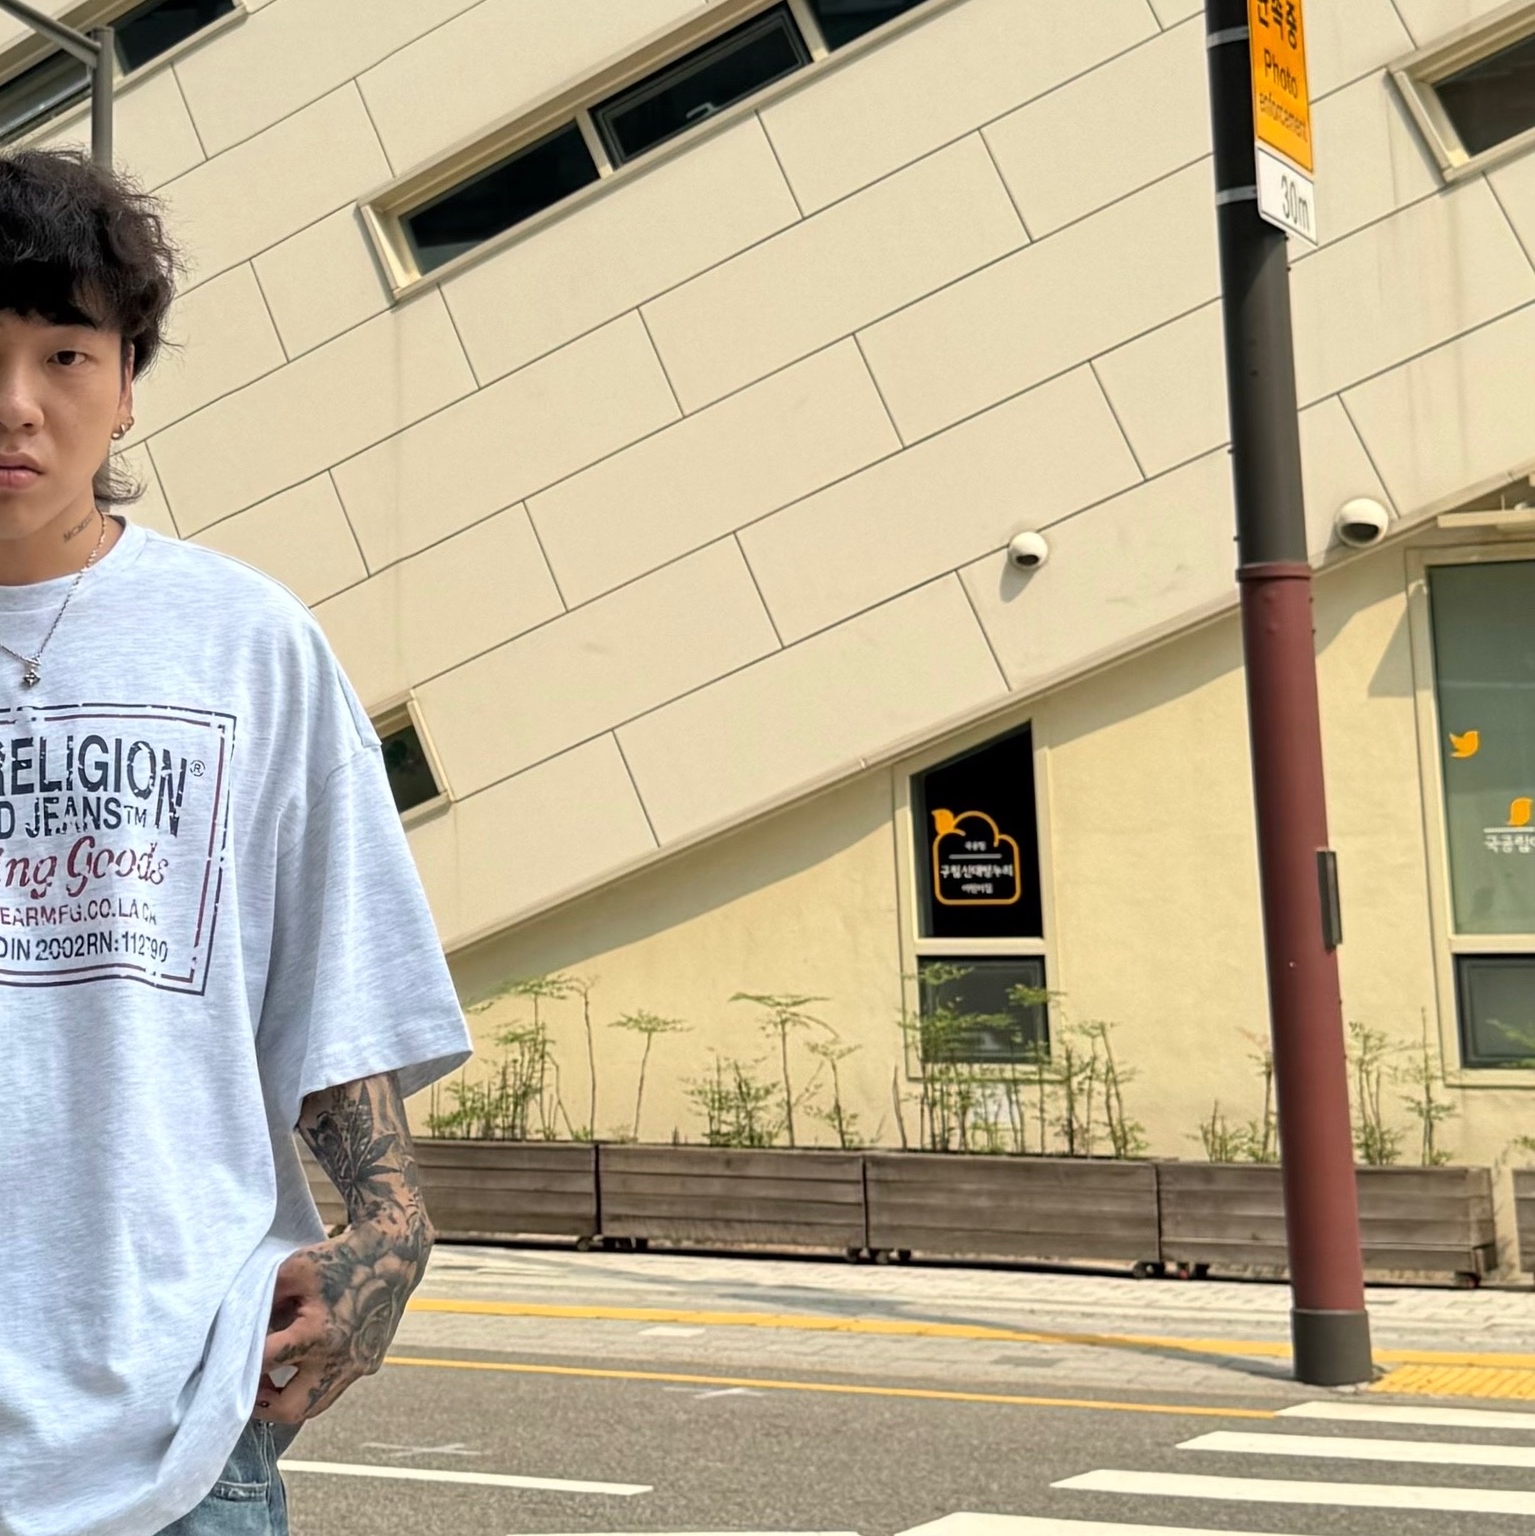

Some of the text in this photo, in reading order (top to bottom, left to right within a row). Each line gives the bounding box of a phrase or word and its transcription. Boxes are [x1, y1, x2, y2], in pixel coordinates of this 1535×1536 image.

[1263, 48, 1299, 99] Photo
[1280, 175, 1311, 232] 30m
[65, 834, 169, 898] Goods
